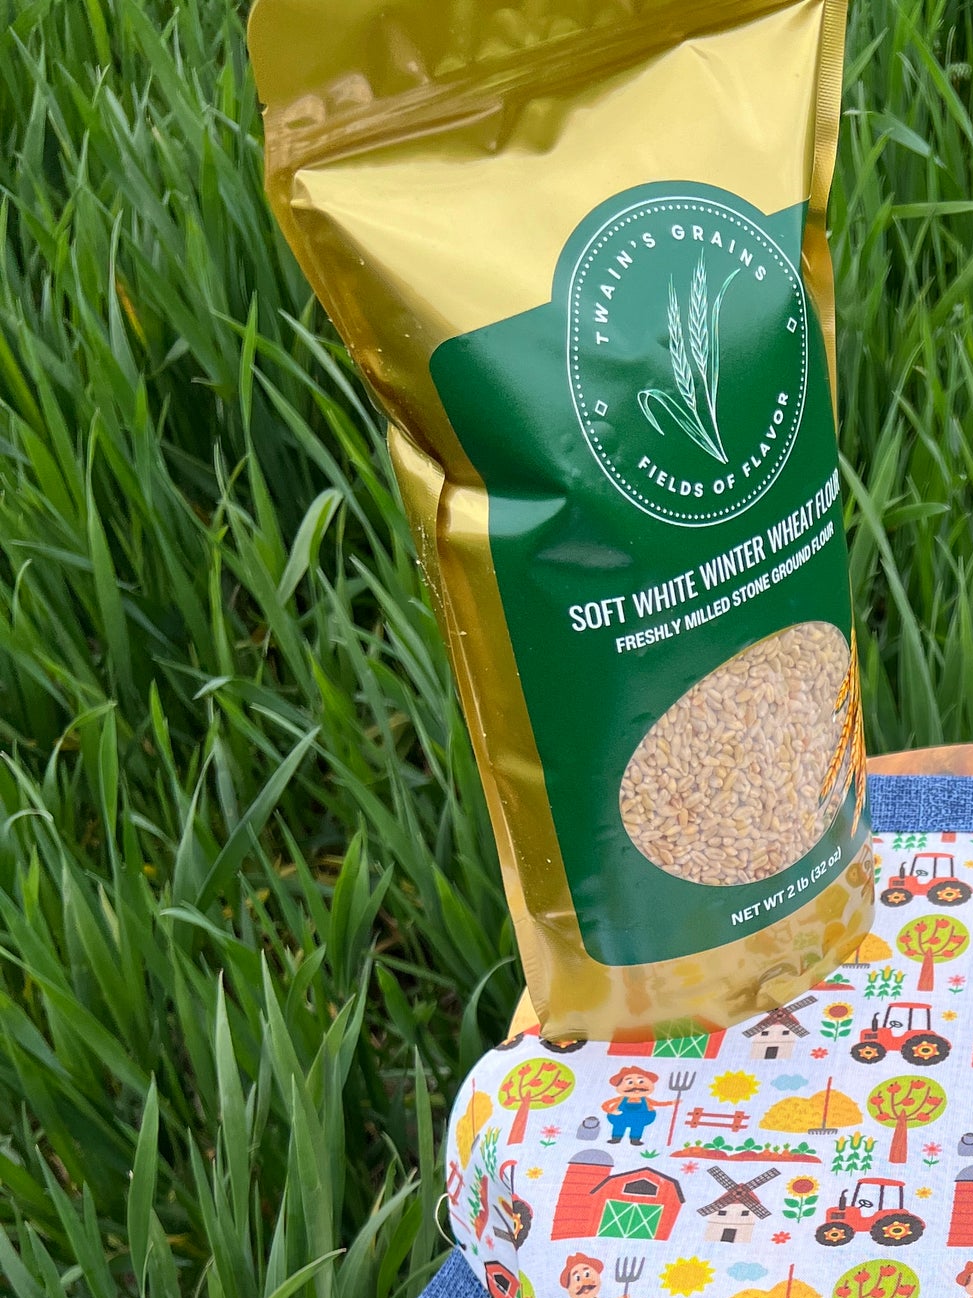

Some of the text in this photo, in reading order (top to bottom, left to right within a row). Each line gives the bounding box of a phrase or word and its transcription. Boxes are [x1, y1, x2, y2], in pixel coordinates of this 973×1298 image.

[671, 224, 767, 281] GRAINS
[638, 392, 789, 497] FIELDS OF FLAVOR
[569, 467, 841, 632] SOFT WHITE WINTER WHEAT FLOUR
[615, 520, 835, 653] FRESHLY MILLED STONE GROUND FLOUR
[731, 846, 842, 926] NET WT 2 lb (32 oz)
